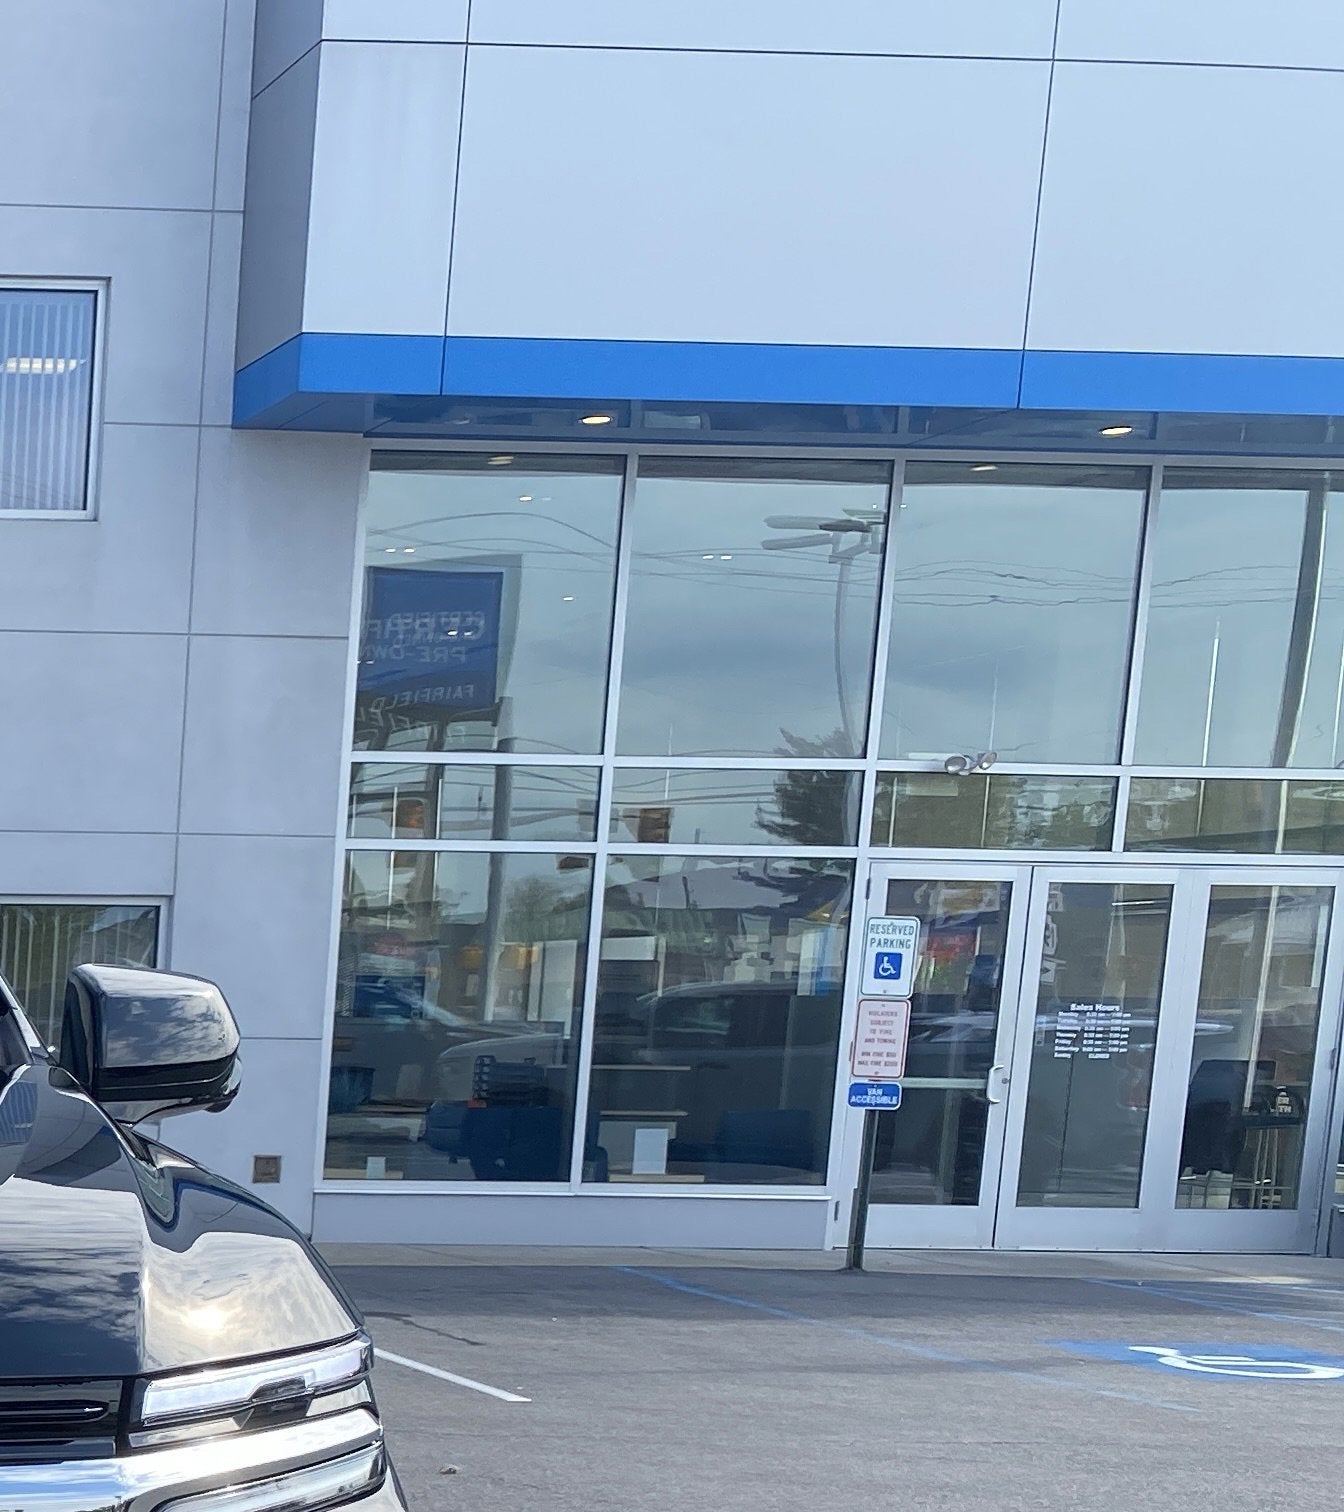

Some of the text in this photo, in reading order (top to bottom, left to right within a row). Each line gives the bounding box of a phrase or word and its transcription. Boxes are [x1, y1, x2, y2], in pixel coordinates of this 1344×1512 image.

[869, 923, 915, 936] RESERVED
[869, 937, 912, 949] PARKING
[867, 1088, 883, 1096] VAN
[850, 1095, 898, 1105] ACCESSIBLE
